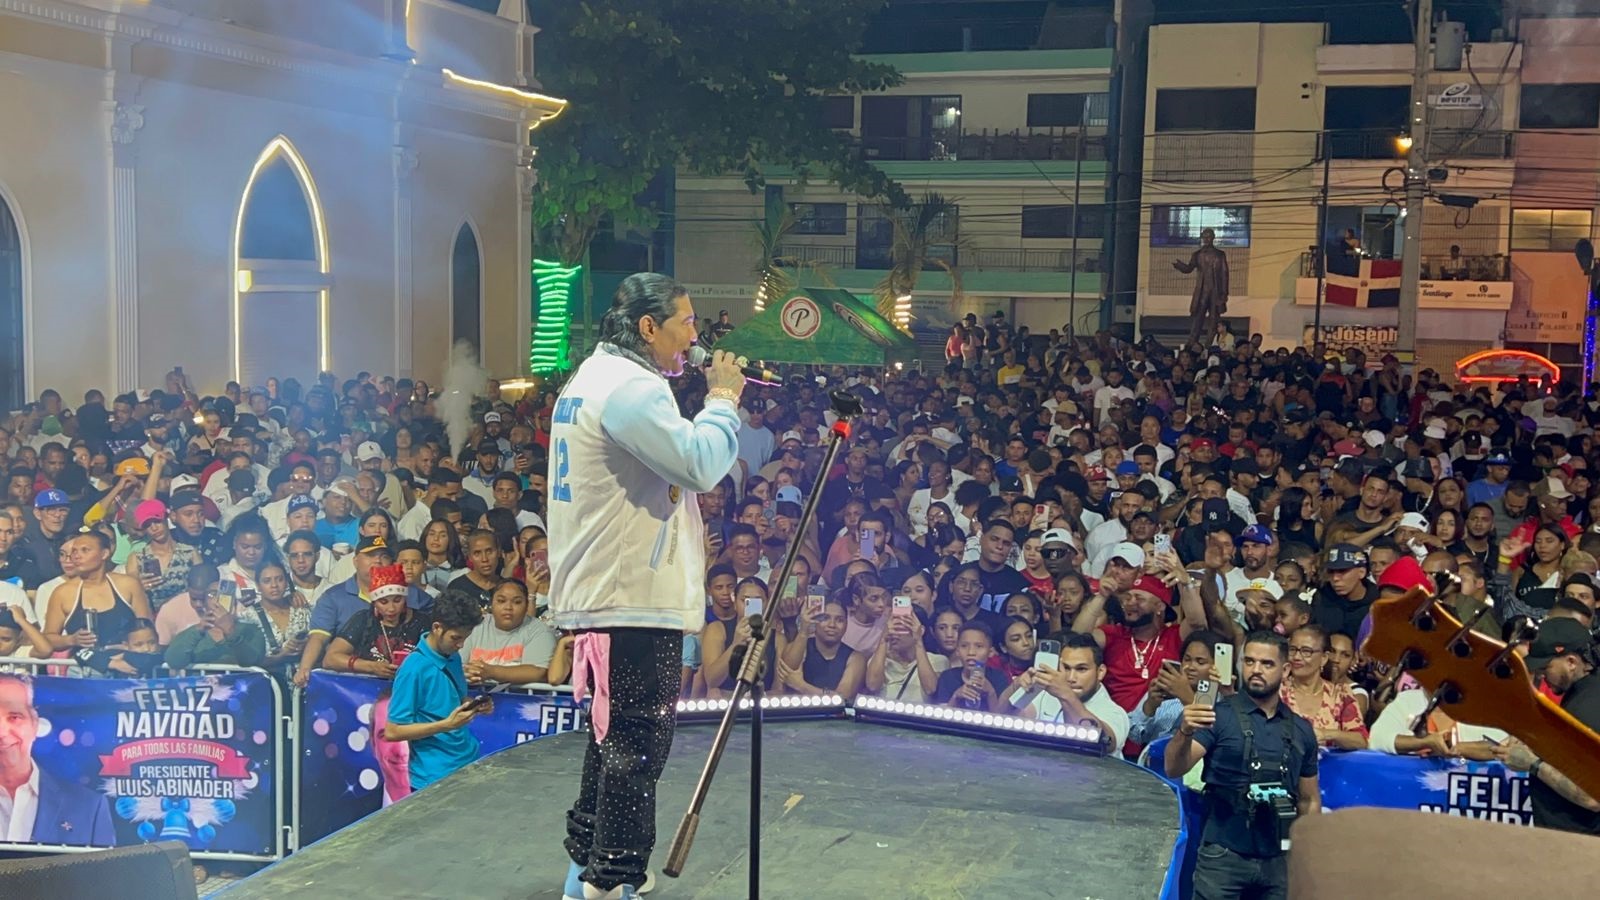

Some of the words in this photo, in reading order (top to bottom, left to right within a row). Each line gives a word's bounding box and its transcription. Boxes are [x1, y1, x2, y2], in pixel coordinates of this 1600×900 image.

[790, 307, 810, 328] P
[134, 686, 212, 712] FELIZ
[116, 711, 235, 740] NAVIDAD
[121, 745, 143, 761] PARA
[143, 742, 170, 756] TODAS
[170, 742, 187, 755] LAS
[187, 742, 227, 762] FAMILIAS
[138, 765, 211, 779] PRESIDENTE
[116, 778, 153, 797] LUIS
[155, 778, 235, 799] ABINADER
